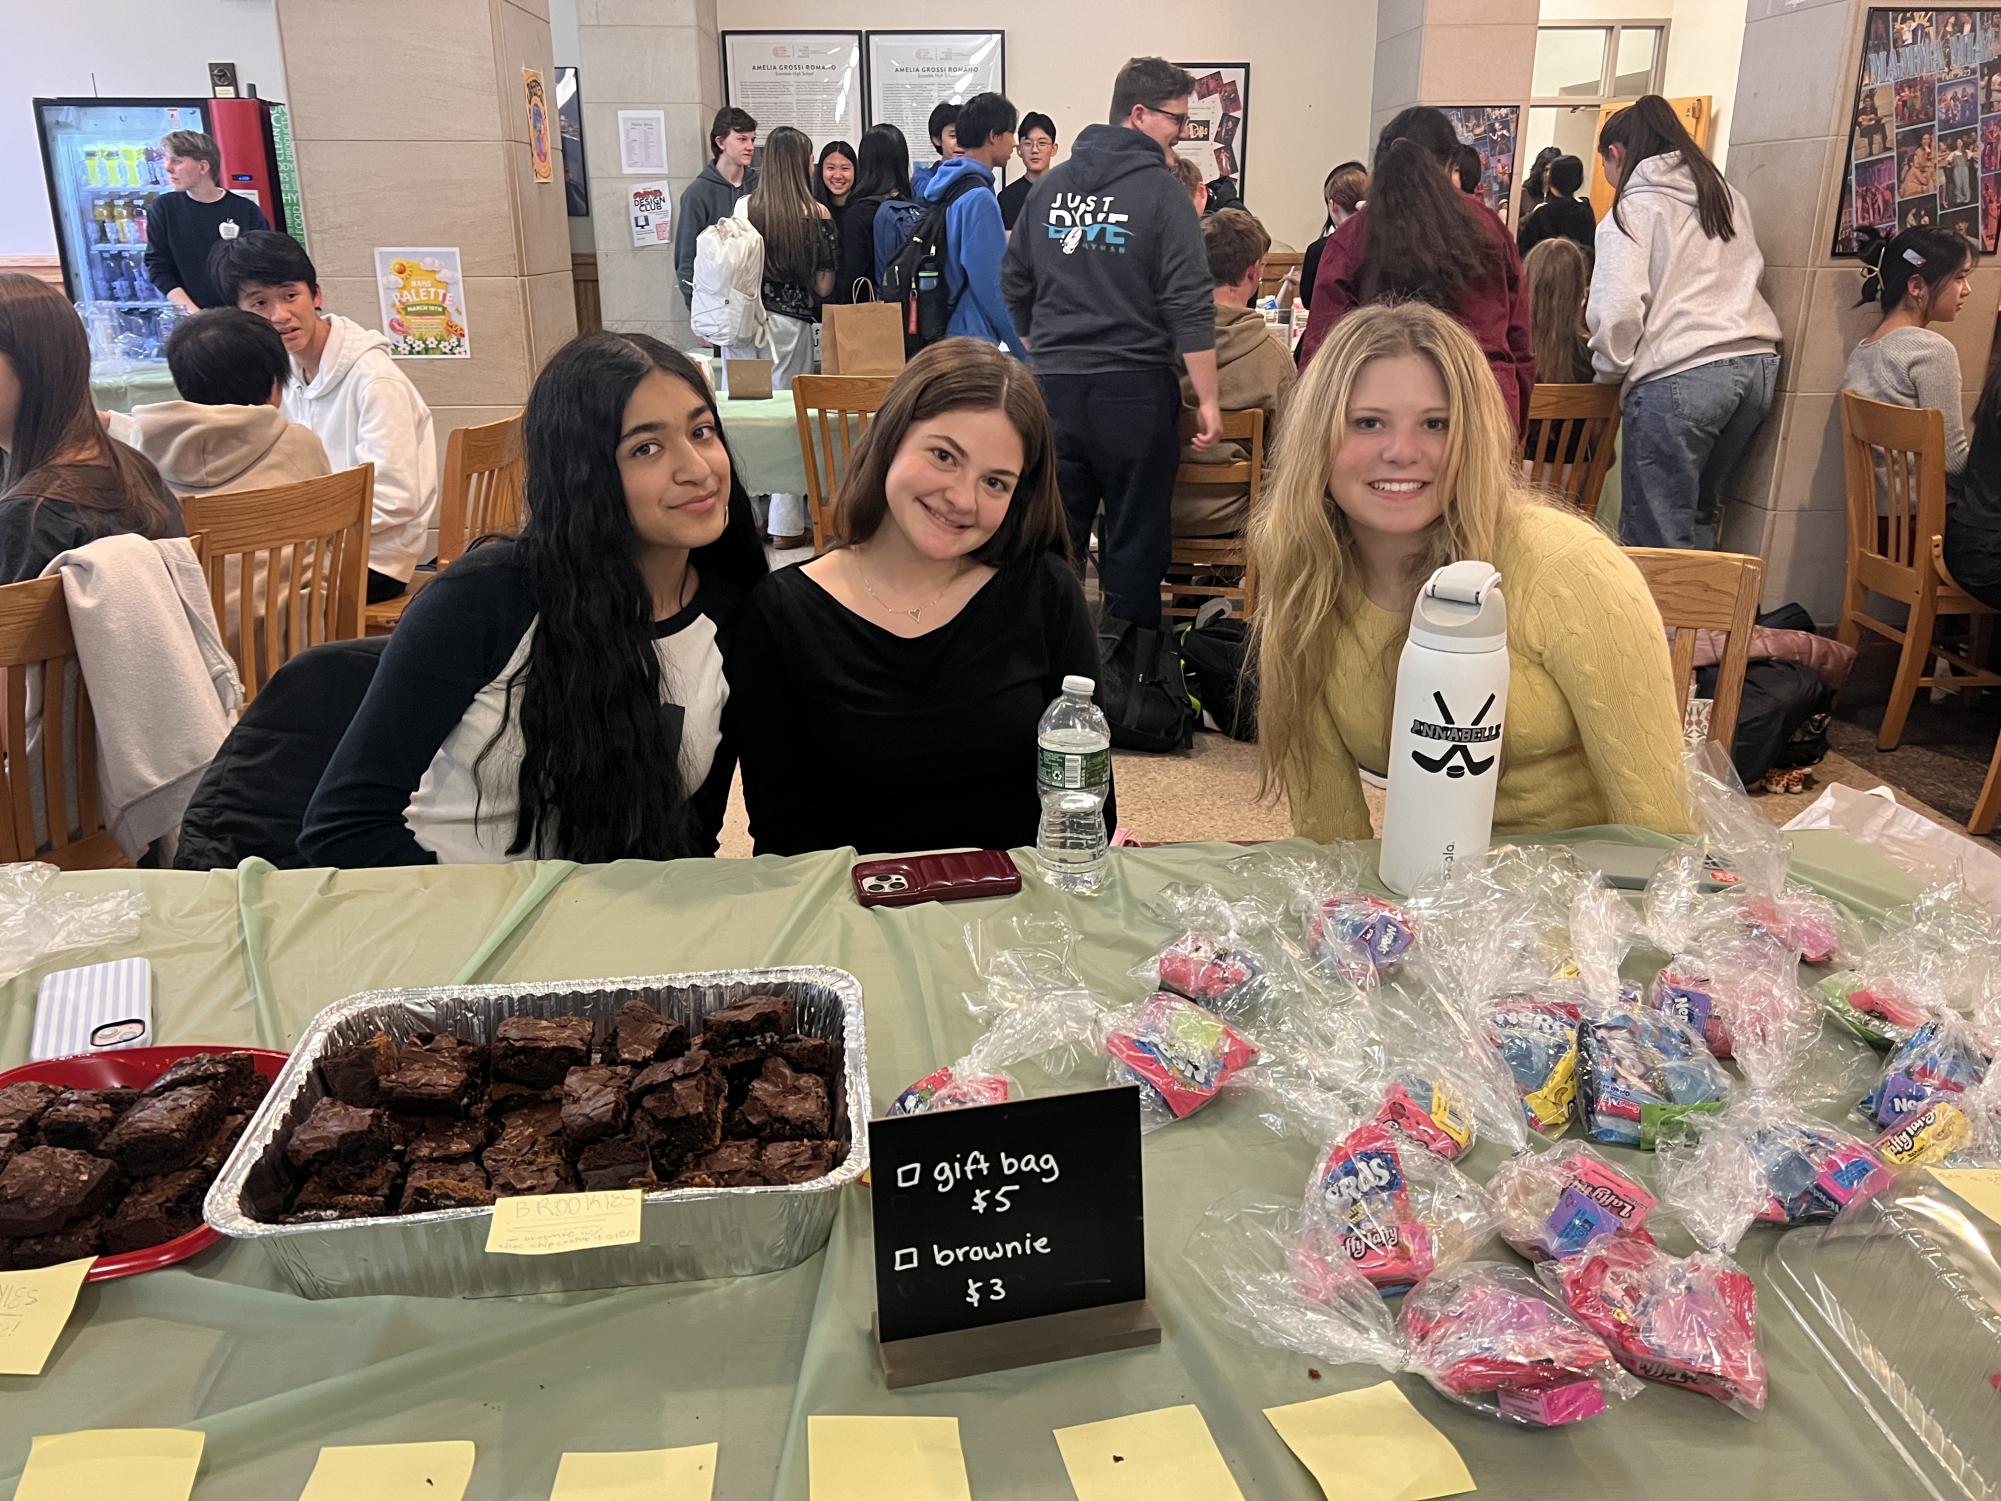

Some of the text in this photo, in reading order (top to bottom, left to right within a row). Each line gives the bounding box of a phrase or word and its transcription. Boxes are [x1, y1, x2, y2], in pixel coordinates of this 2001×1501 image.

[634, 196, 666, 206] DESIGN
[639, 204, 662, 212] CLUB
[1051, 192, 1114, 212] JUST
[392, 288, 454, 305] PALETTE
[933, 1150, 1060, 1193] gift bag
[516, 1193, 636, 1218] BROOKIES
[971, 1185, 1020, 1214] $5
[1591, 1184, 1635, 1218] Laffy
[932, 1232, 1051, 1267] brownie
